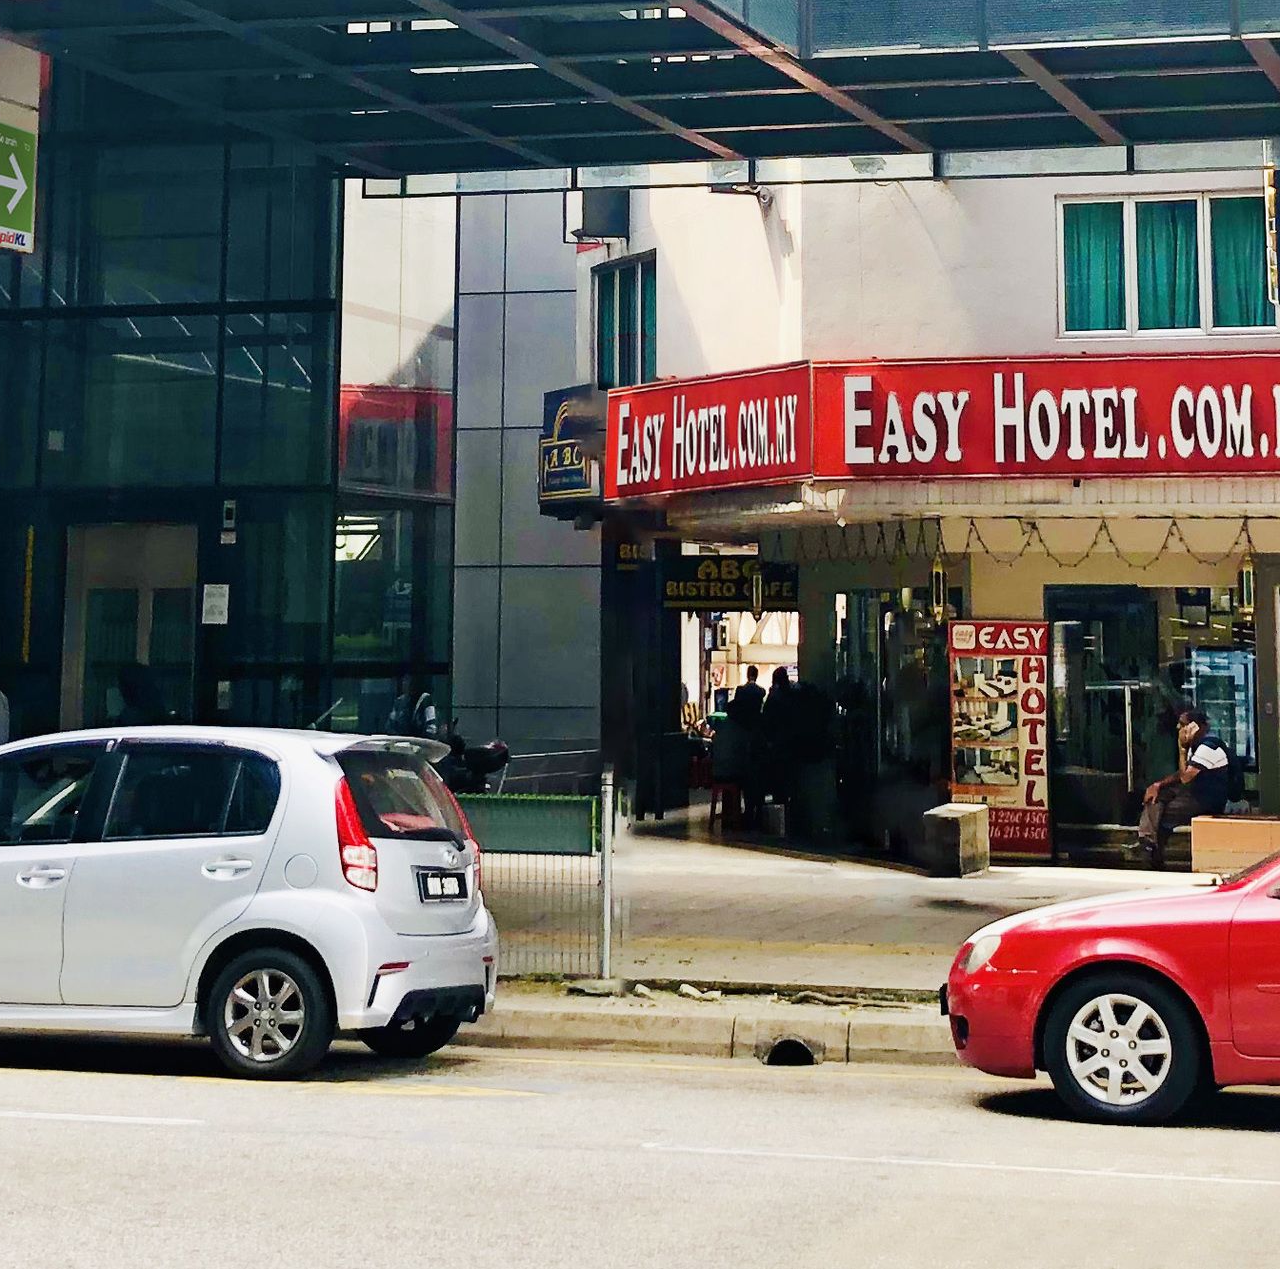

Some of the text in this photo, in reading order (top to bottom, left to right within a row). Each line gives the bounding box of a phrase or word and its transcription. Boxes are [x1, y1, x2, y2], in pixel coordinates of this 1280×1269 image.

[616, 403, 666, 486] EASY
[843, 375, 970, 464] EASY
[666, 581, 736, 597] BISTRO
[978, 626, 1045, 650] EASY
[1021, 657, 1046, 807] HOTEL
